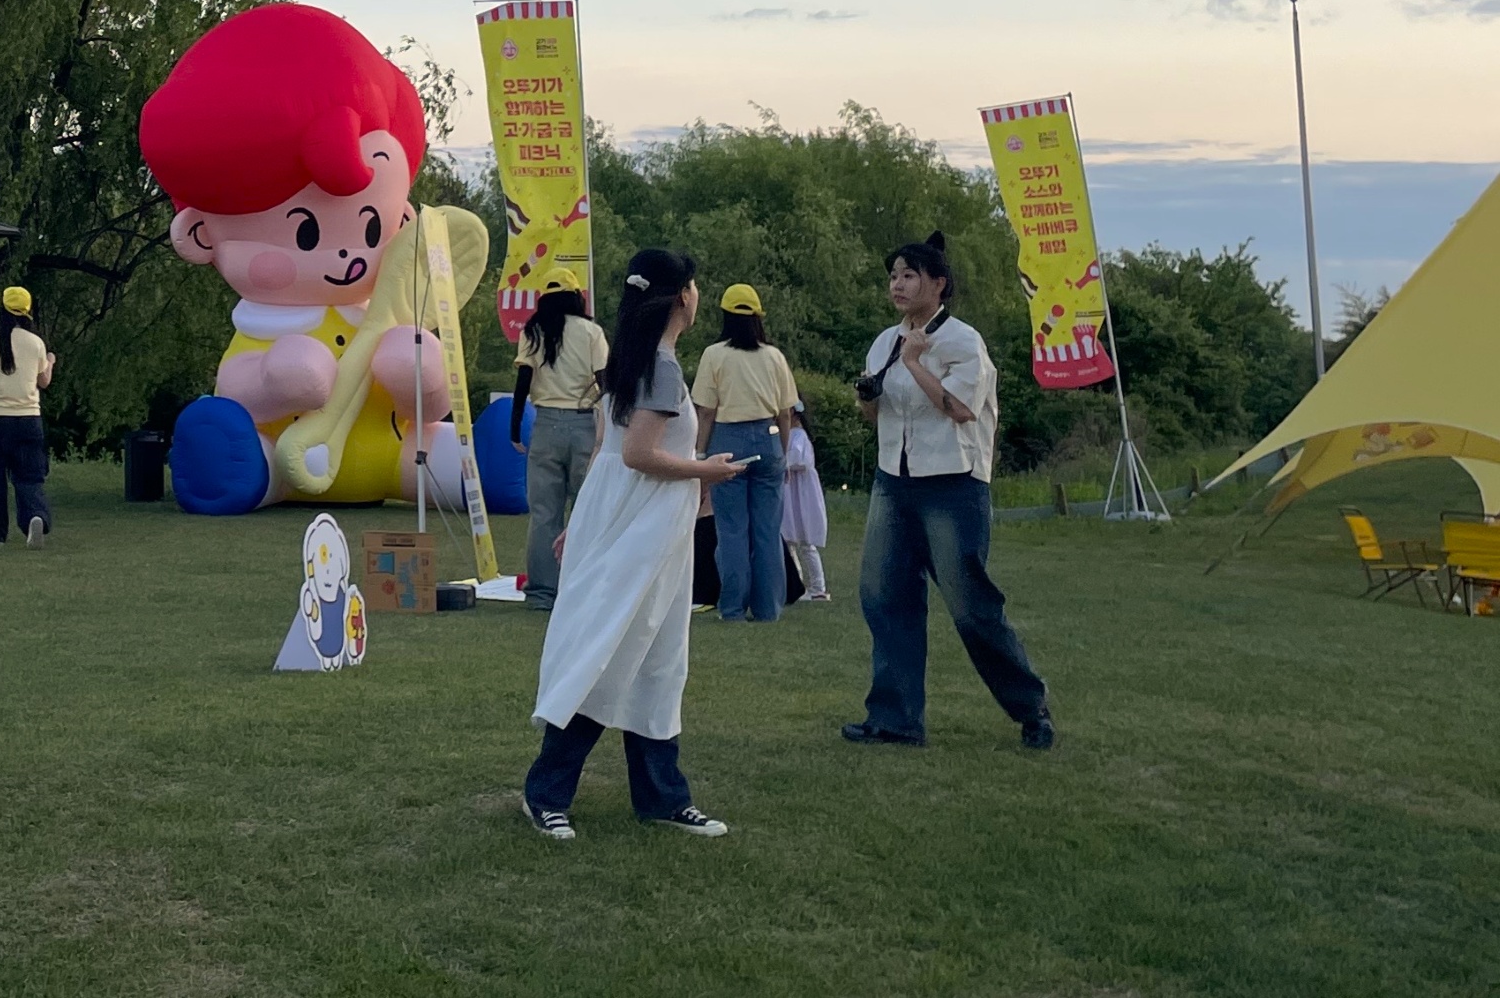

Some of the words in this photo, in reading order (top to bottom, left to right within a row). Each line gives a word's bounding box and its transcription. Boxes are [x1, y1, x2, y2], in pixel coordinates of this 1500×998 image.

[503, 77, 564, 95] 오뚜기가
[504, 99, 566, 117] 함께하는
[519, 144, 561, 161] 피크닉
[1019, 165, 1059, 180] 오뚜기
[1024, 183, 1063, 198] 소스와
[1020, 202, 1074, 218] 함께하는
[1039, 239, 1066, 254] 체험
